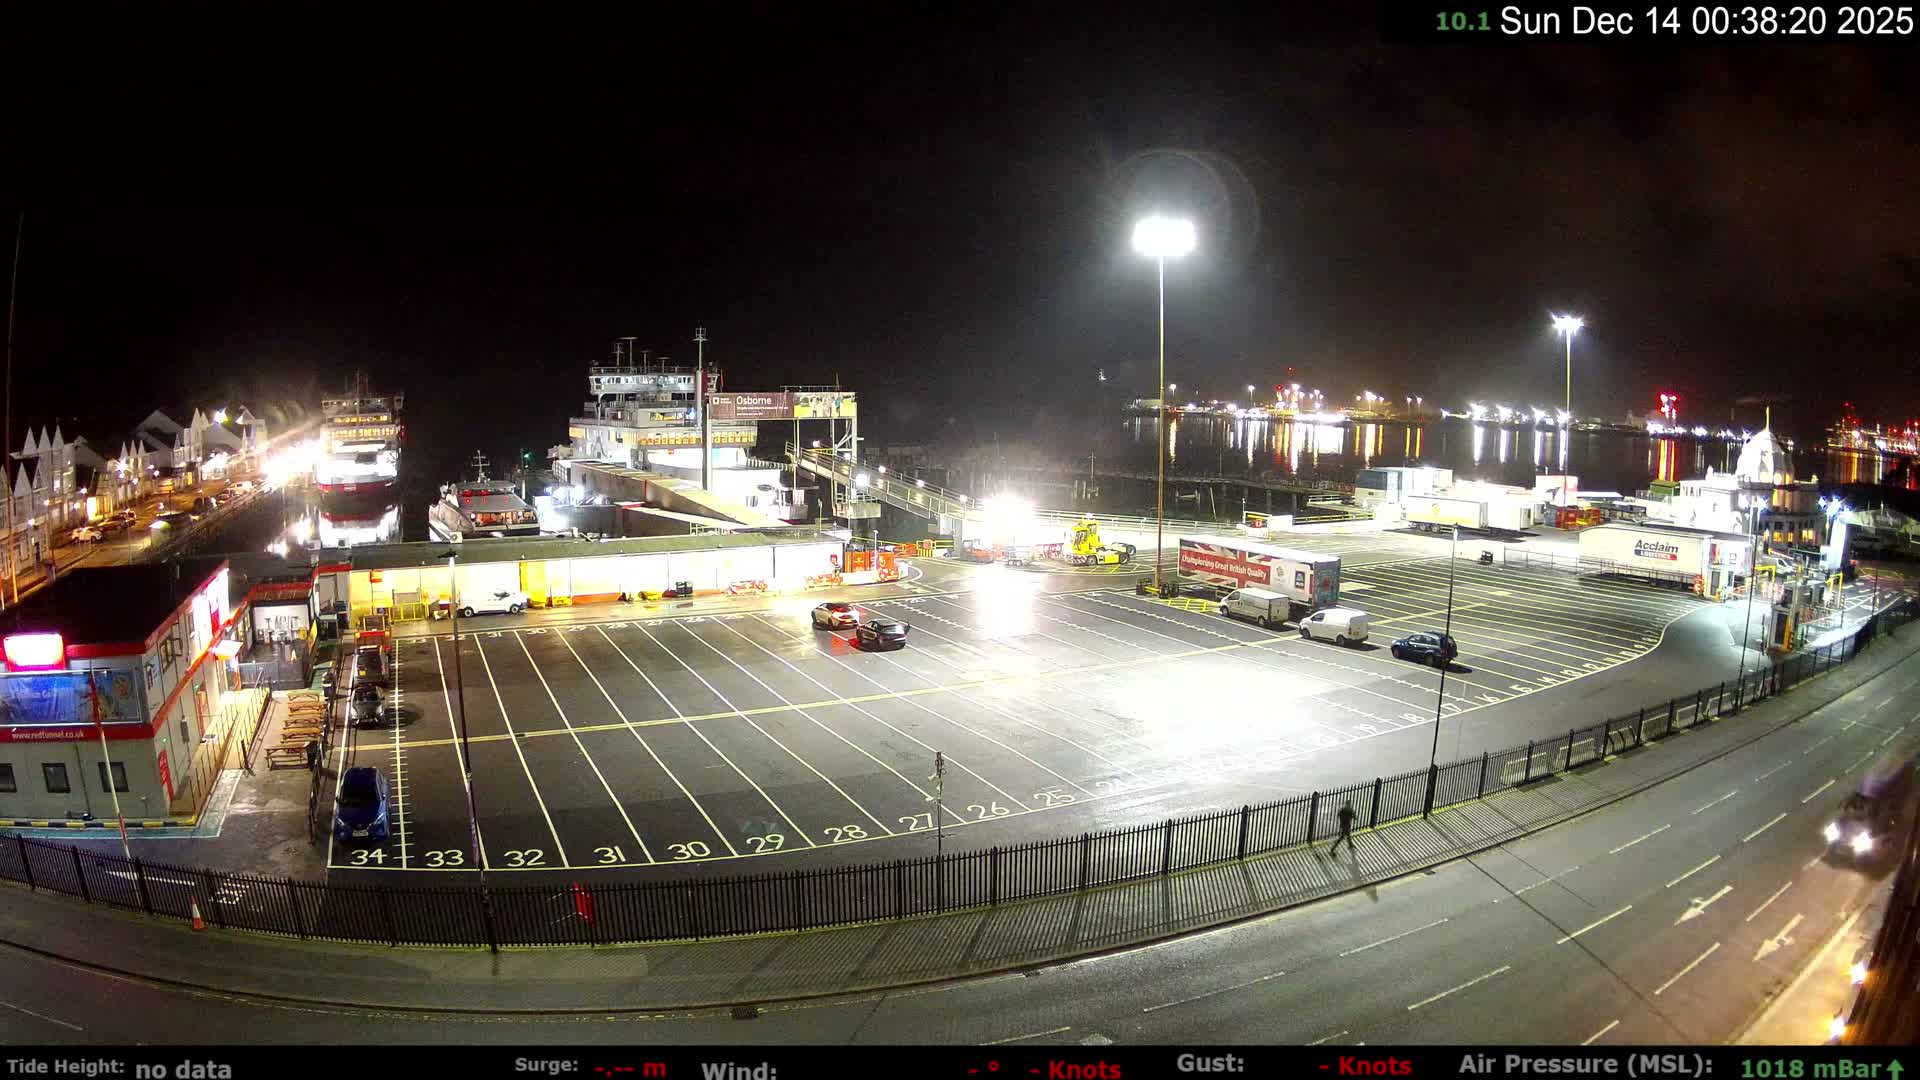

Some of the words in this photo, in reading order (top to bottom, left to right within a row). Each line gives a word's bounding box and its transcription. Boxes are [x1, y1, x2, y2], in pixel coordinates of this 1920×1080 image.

[736, 395, 772, 405] Osborne
[1635, 539, 1679, 553] Acclaim
[1214, 561, 1229, 572] Great
[1229, 565, 1247, 574] British
[1246, 567, 1267, 580] Quality
[1033, 788, 1076, 807] 25
[966, 801, 1010, 820] 26
[898, 813, 934, 832] 27
[746, 833, 785, 854] 29
[823, 824, 868, 844] 28
[350, 848, 388, 867] 34
[424, 849, 465, 868] 33
[503, 849, 546, 867] 32
[594, 846, 626, 864] 31
[667, 841, 711, 861] 30
